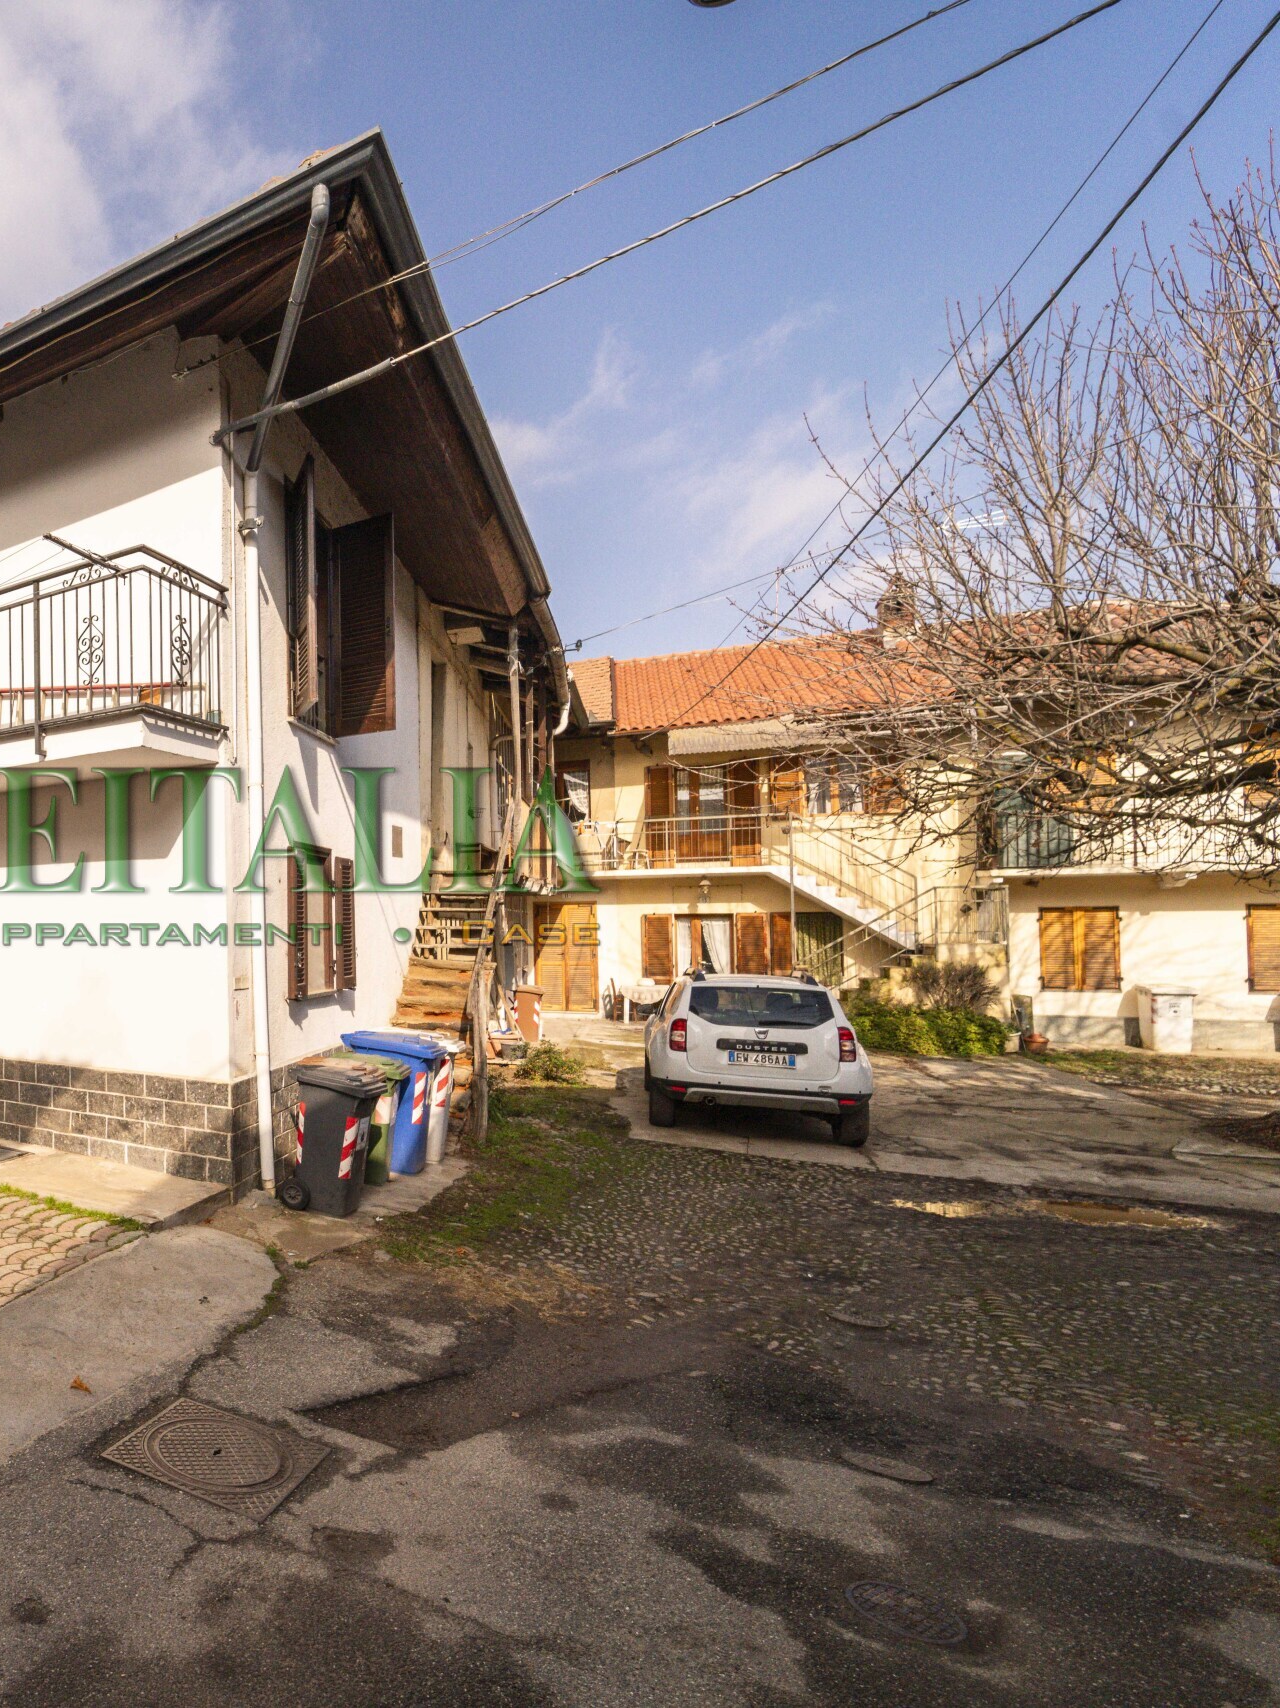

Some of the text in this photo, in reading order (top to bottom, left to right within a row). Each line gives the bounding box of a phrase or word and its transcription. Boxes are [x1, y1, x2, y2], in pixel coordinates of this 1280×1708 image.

[736, 1044, 788, 1052] DUSTER
[736, 1053, 788, 1066] EW 486AA
